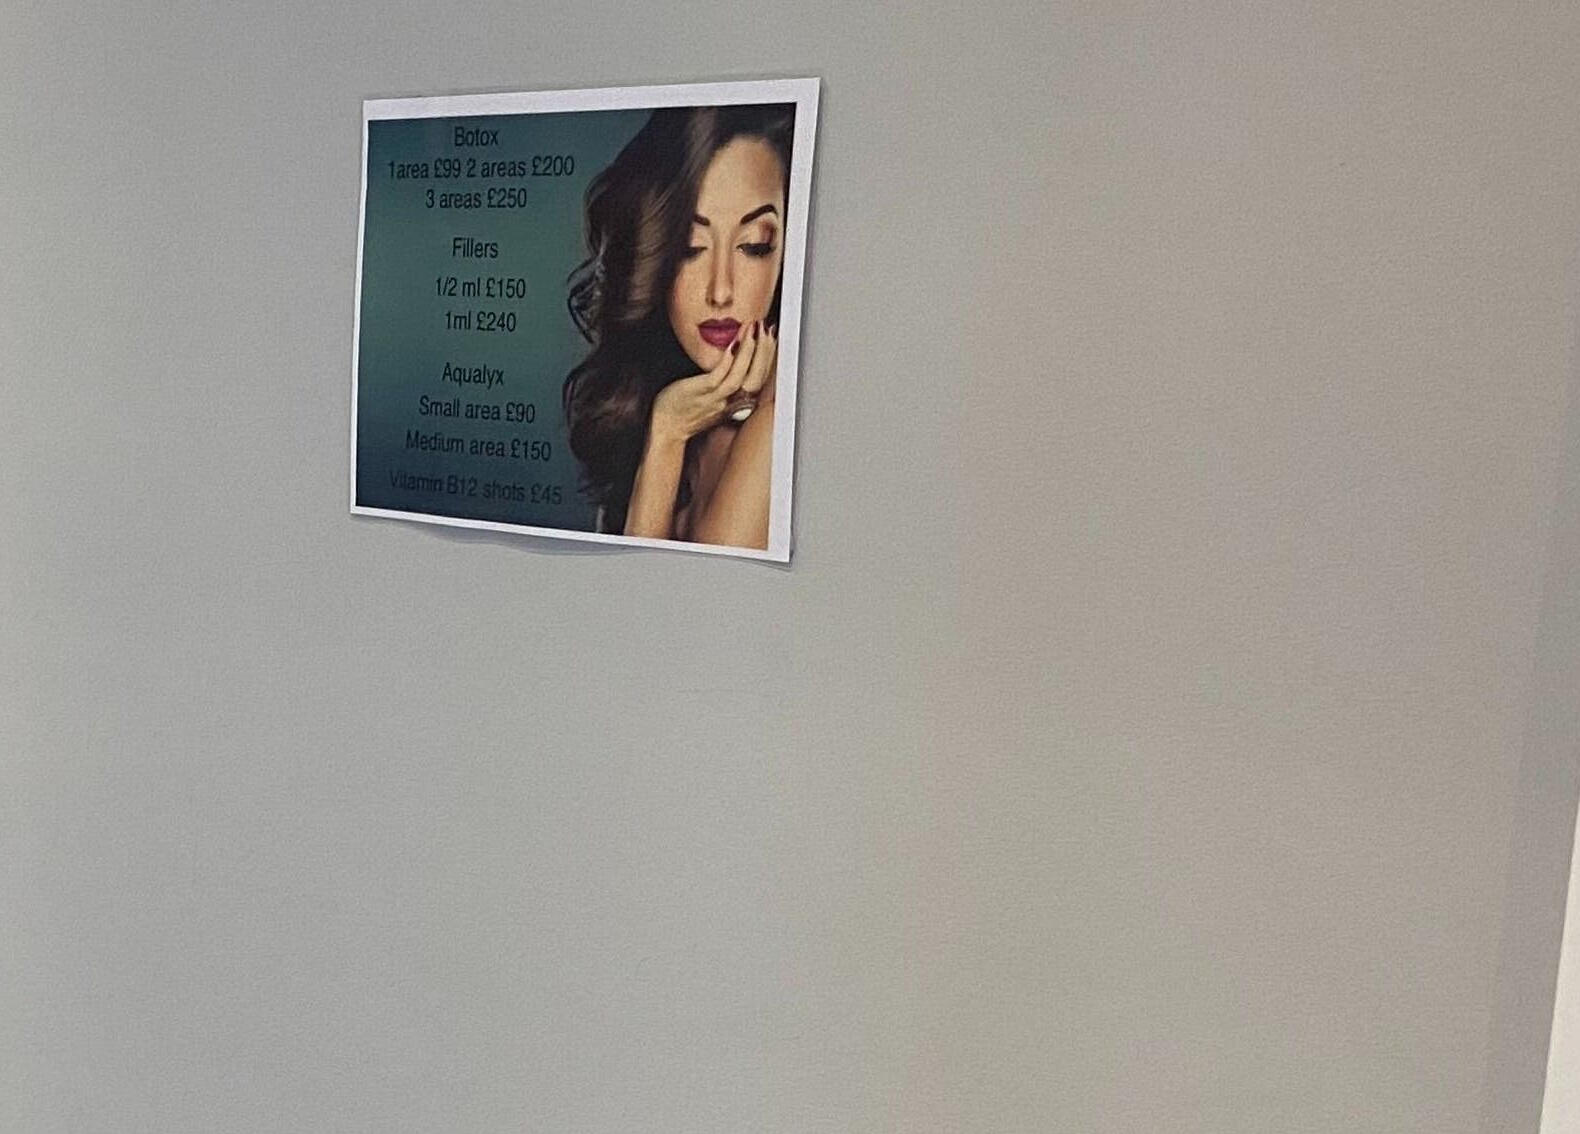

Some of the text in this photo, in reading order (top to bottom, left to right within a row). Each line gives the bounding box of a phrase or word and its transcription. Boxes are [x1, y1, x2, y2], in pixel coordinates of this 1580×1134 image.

[454, 126, 500, 147] Botox
[434, 158, 461, 179] £99
[466, 157, 476, 178] 2
[481, 158, 526, 177] areas
[531, 155, 575, 176] £200
[426, 187, 528, 209] 3 areas £250
[452, 237, 499, 258] Fillers
[436, 277, 526, 299] 1/2 ml £150
[445, 310, 517, 333] 1ml £240
[442, 362, 505, 390] Aqualyx
[419, 395, 536, 424] Small area £90
[405, 429, 552, 461] Medium area £150
[389, 470, 562, 505] Vitamin B12 shots £45
